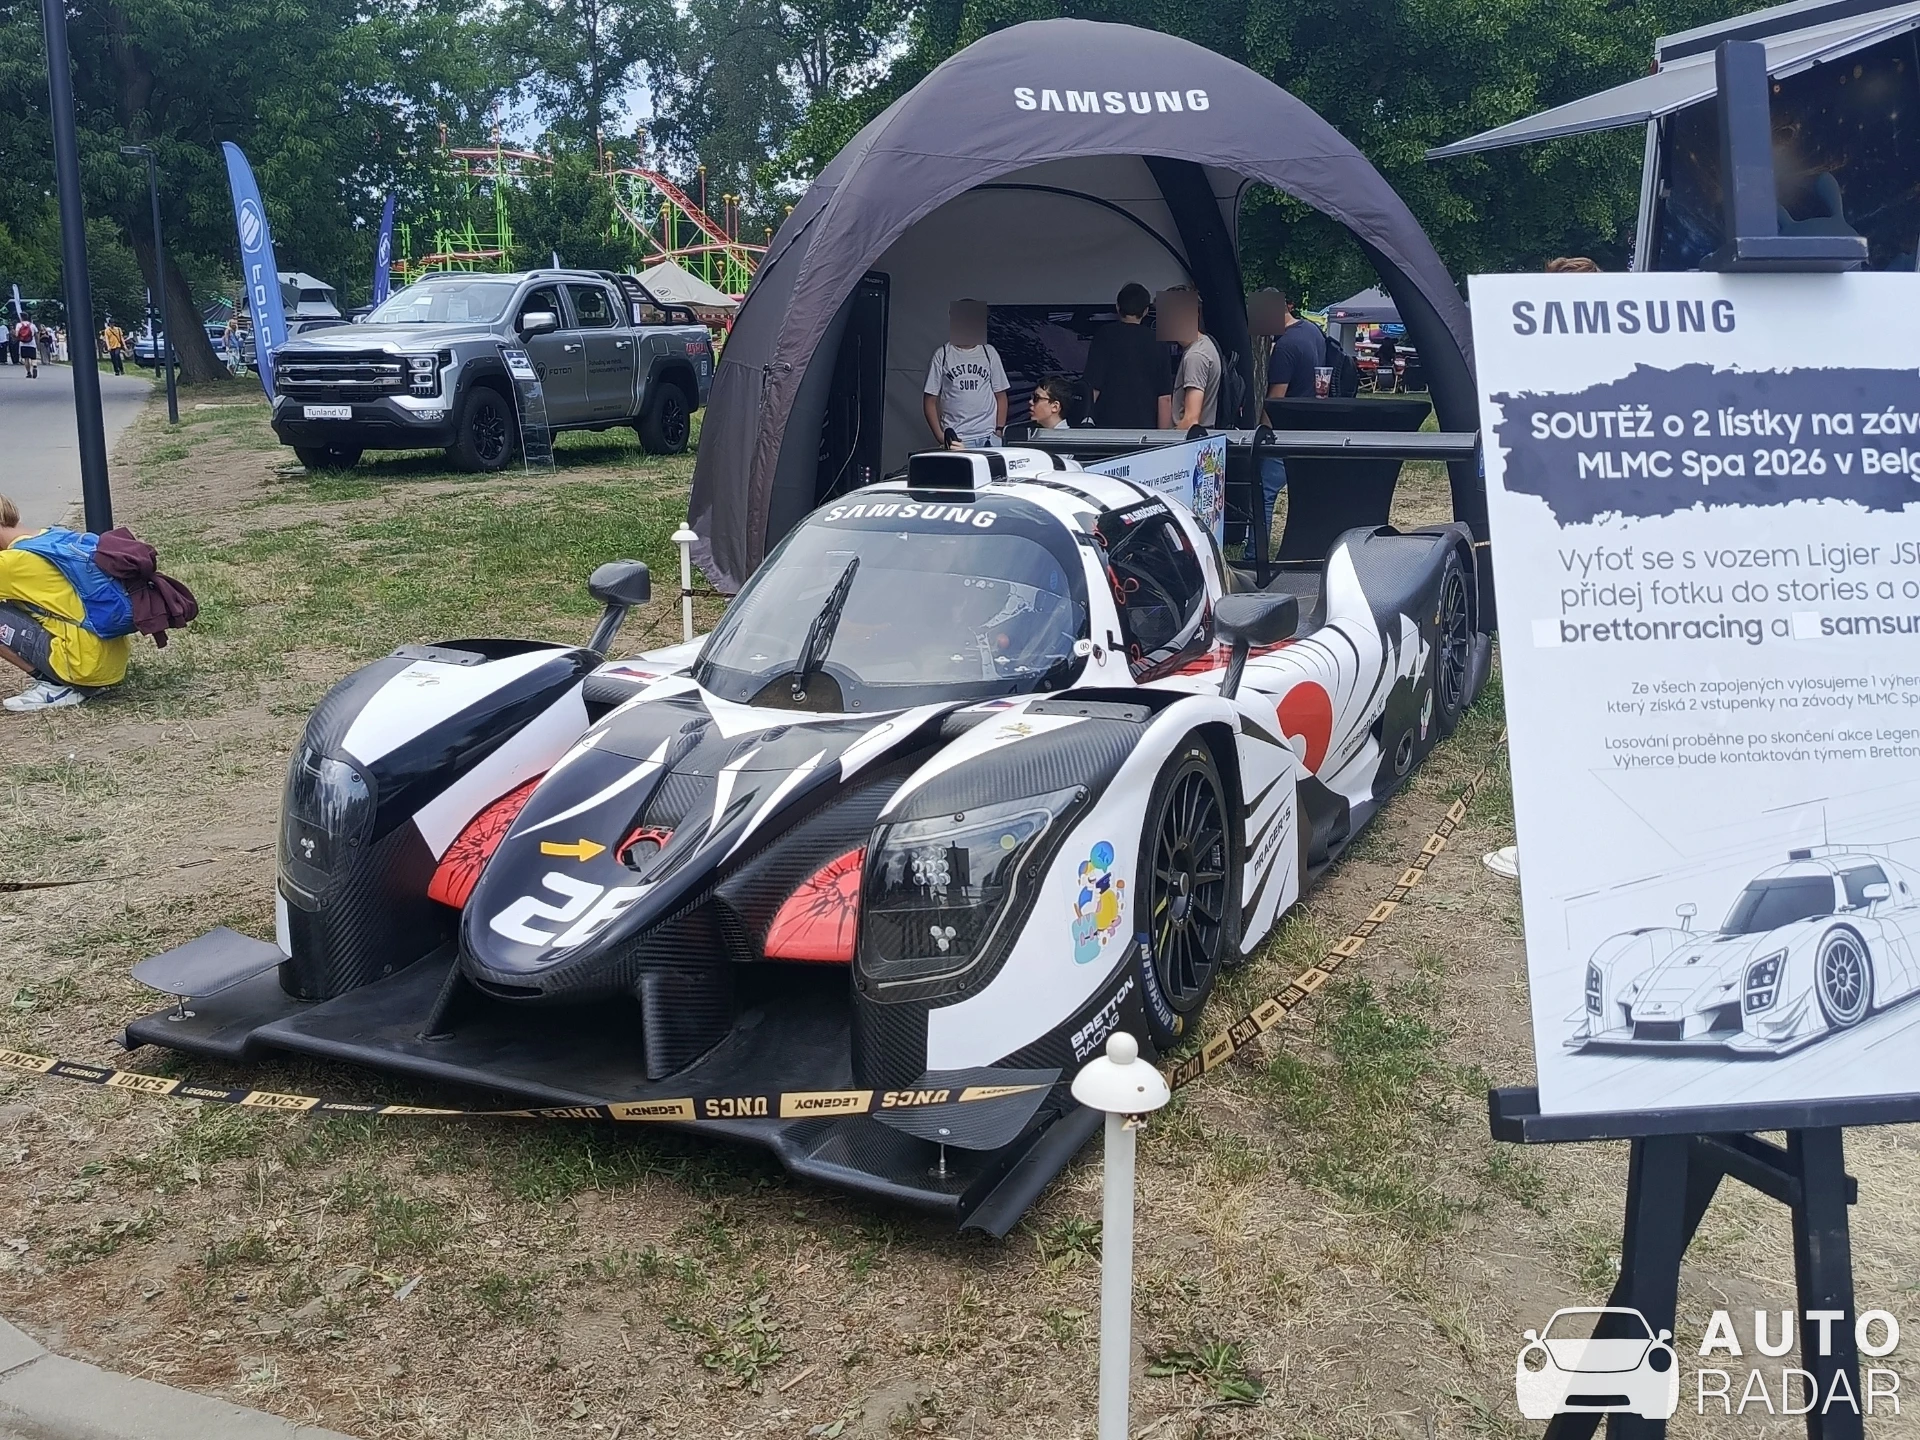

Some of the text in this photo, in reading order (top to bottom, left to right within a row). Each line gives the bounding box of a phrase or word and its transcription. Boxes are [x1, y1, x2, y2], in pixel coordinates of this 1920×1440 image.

[1013, 87, 1210, 114] SAMSUNG
[1511, 299, 1736, 335] SAMSUNG
[945, 363, 990, 382] WEST COAST
[959, 379, 979, 391] SURF
[307, 408, 348, 416] Tunland V7
[1531, 403, 1920, 444] SOUTĚŽ o 2 lístky na záv
[1578, 450, 1672, 479] MLMC
[1681, 448, 1745, 485] Spa
[1752, 448, 1827, 476] 2026
[1835, 452, 1853, 475] v
[824, 502, 997, 528] SAMSUNG
[1558, 546, 1635, 579] Vyfoť
[1642, 551, 1674, 571] se
[1682, 550, 1696, 570] s
[1704, 546, 1800, 569] vozem
[1807, 543, 1881, 574] Ligier
[1560, 577, 1920, 614] přidej fotku do stories a o
[1560, 613, 1764, 646] brettonracing
[1771, 618, 1790, 638] a
[1631, 681, 1650, 696] Ze
[1653, 679, 1697, 695] všech
[1699, 676, 1785, 697] zapojených
[1787, 675, 1869, 694] vylosujeme
[1879, 674, 1920, 690] výher
[1607, 699, 1646, 716] který
[1649, 698, 1686, 713] získá
[1689, 698, 1698, 711] 2
[1700, 696, 1776, 713] vstupenky
[1779, 696, 1799, 709] na
[1802, 693, 1853, 710] závody
[1857, 692, 1899, 706] MLMC
[1605, 733, 1669, 750] Losování
[1672, 732, 1745, 749] proběhne
[1748, 734, 1768, 749] po
[1771, 729, 1835, 745] skončení
[1838, 729, 1873, 742] akce
[1613, 753, 1675, 771] Výherce
[1678, 751, 1717, 766] bude
[1720, 748, 1811, 765] kontaktován
[1813, 745, 1867, 762] týmem
[1253, 806, 1292, 877] PRAGER'S
[1140, 943, 1172, 1027] MICHELIN
[1276, 986, 1305, 1008] UNCS
[1071, 975, 1135, 1049] BRETTON
[1075, 1011, 1120, 1063] RACING
[1230, 1019, 1258, 1045] UNCS
[0, 1052, 47, 1070] UNCS
[57, 1066, 105, 1079] LEGENDY
[1176, 1056, 1201, 1087] UNCS
[117, 1075, 170, 1091] UNCS
[180, 1086, 231, 1099] LEGENDY
[252, 1093, 312, 1109] UNCS
[322, 1103, 376, 1111] LEGENDY
[625, 1104, 685, 1116] LEGENDY
[706, 1096, 768, 1117] UNCS
[793, 1097, 860, 1109] LEGENDY
[881, 1089, 950, 1108] UNCS
[540, 1107, 602, 1119] UNCS
